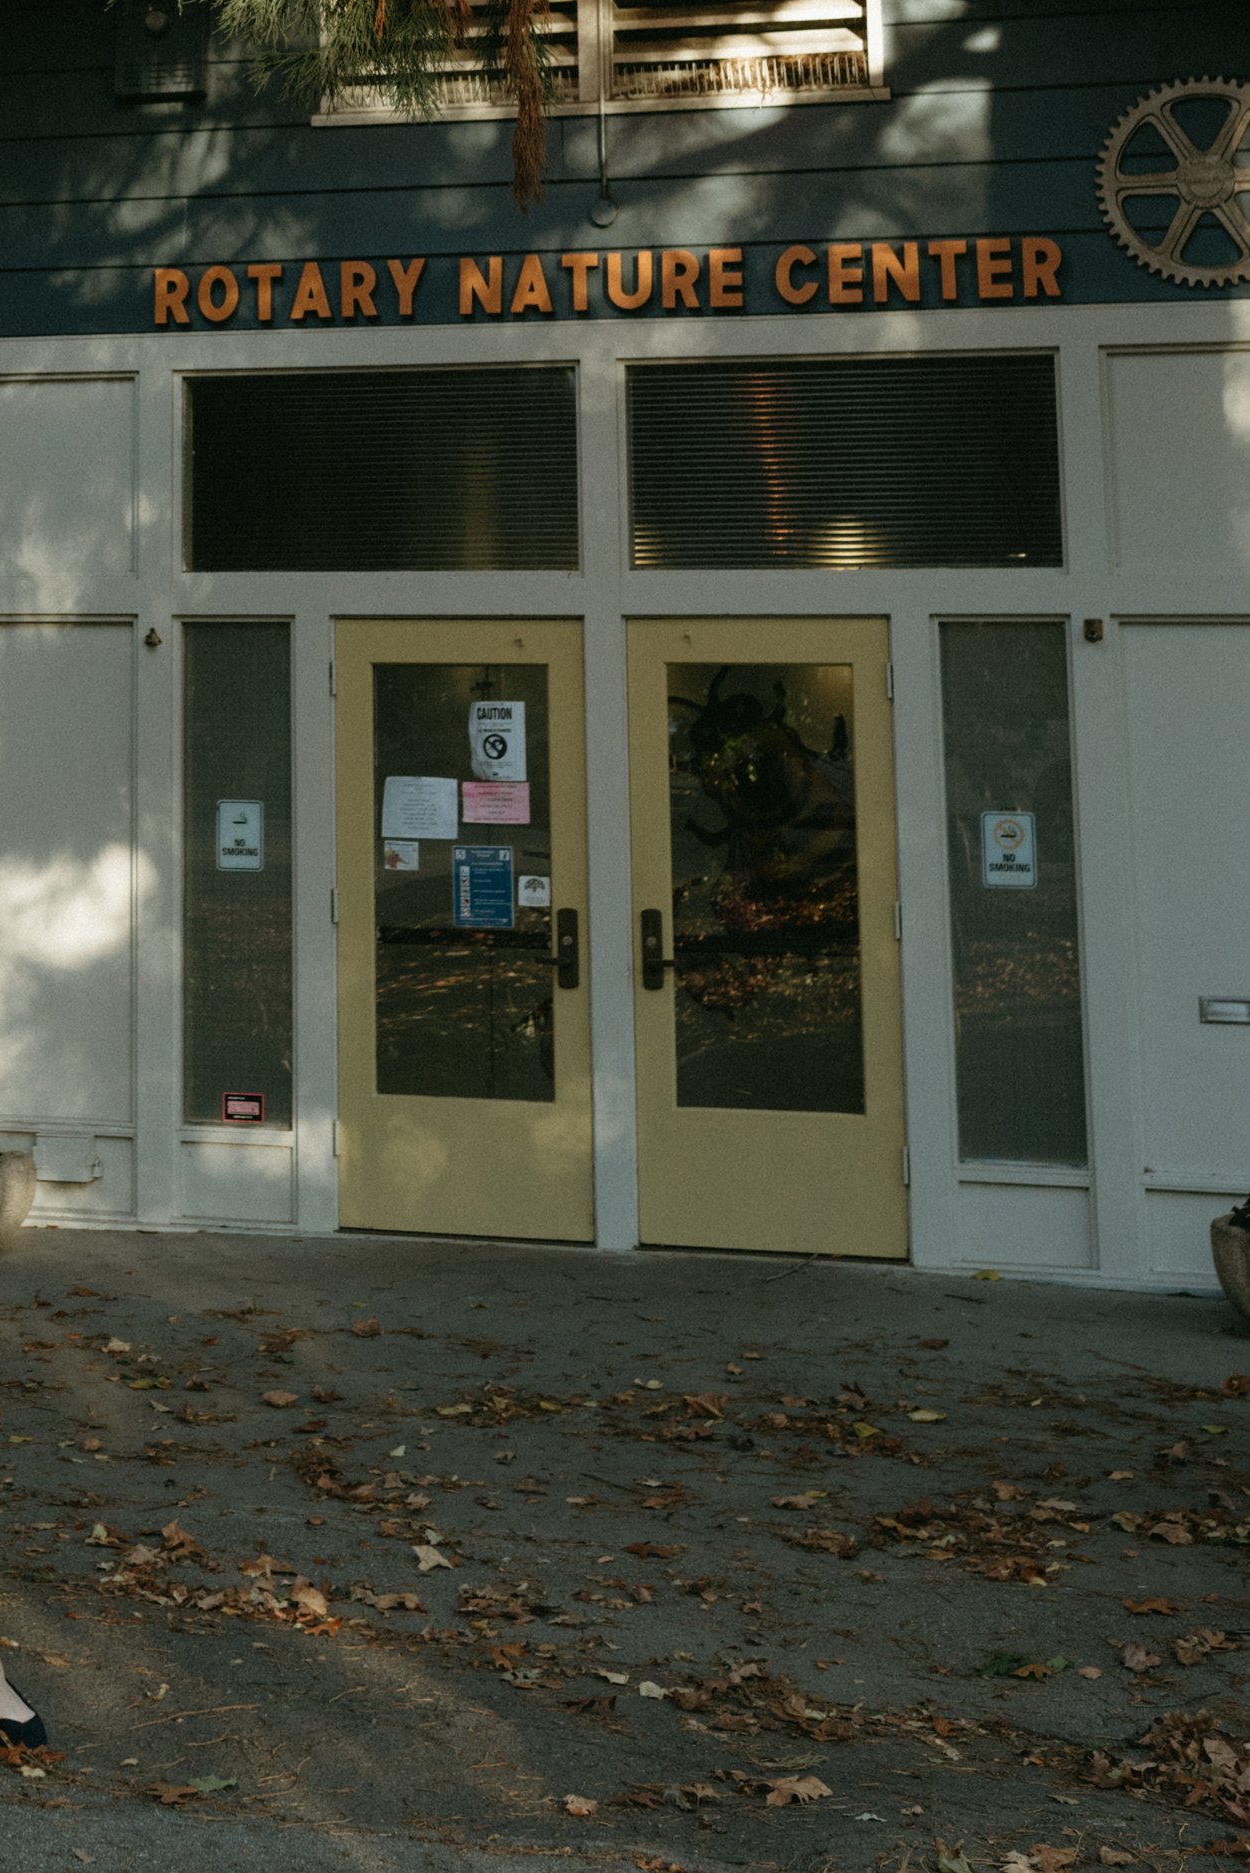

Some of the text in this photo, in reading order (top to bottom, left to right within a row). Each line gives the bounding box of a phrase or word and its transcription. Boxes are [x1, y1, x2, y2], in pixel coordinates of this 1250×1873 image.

[153, 237, 1063, 324] ROTARY NATURE CENTER
[476, 707, 513, 721] CAUTION
[234, 838, 246, 848] NO
[221, 847, 259, 857] SMOKING
[1002, 853, 1016, 863] NO
[988, 863, 1031, 873] SMOKING
